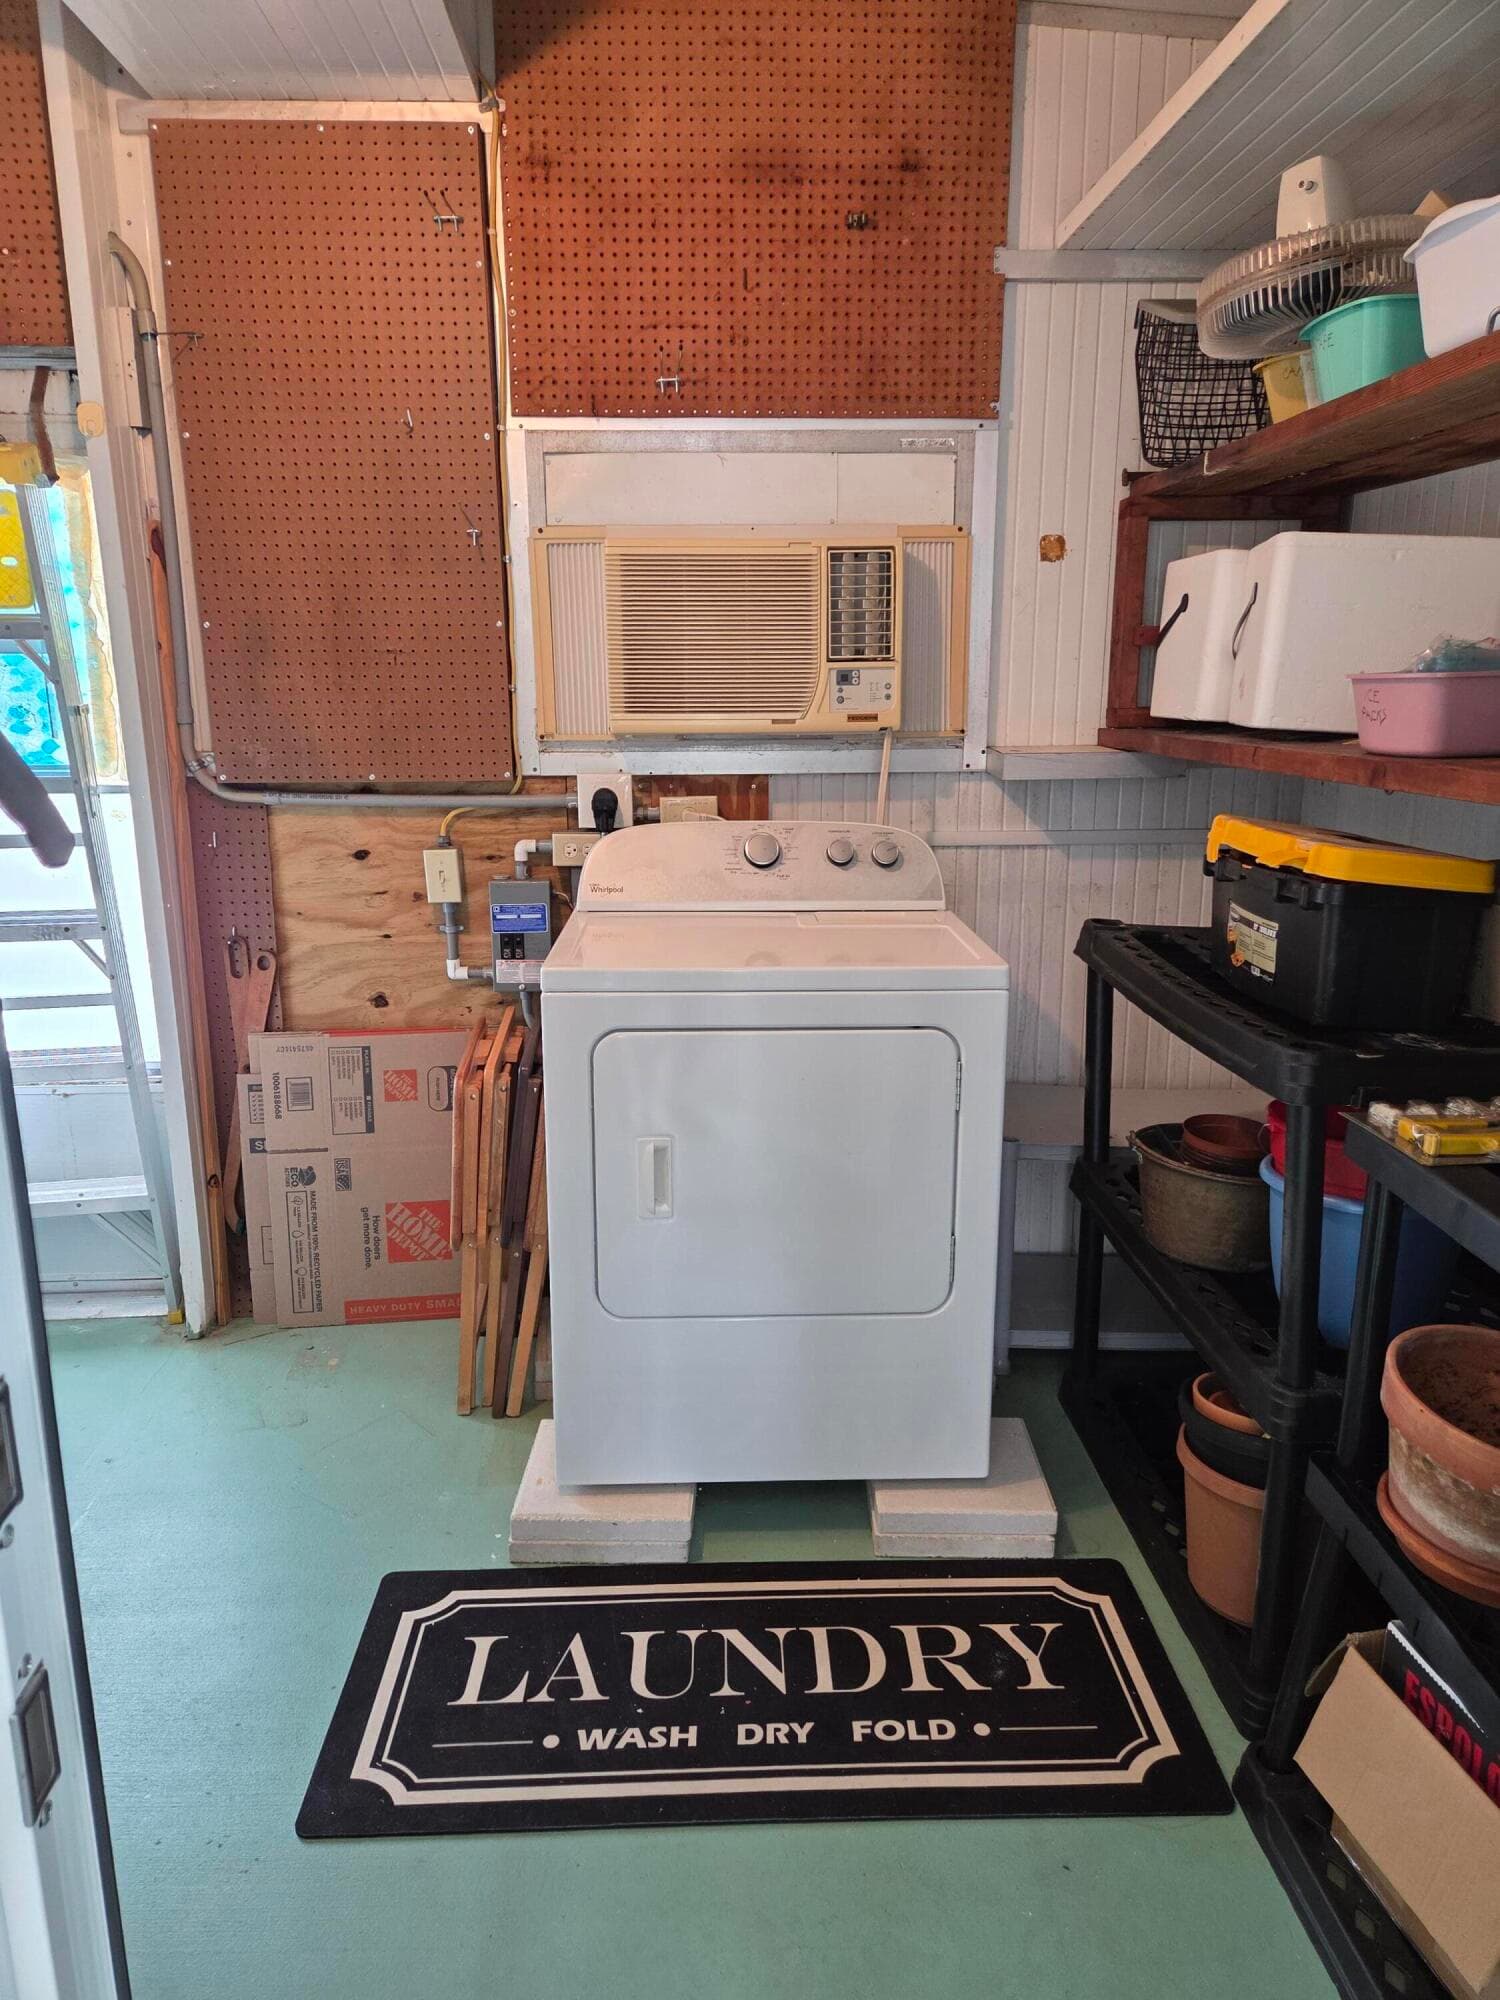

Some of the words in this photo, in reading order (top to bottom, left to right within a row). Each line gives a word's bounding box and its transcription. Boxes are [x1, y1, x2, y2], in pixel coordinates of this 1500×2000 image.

[591, 886, 624, 894] Whirlpool
[273, 1071, 283, 1120] 1006188668
[290, 1167, 299, 1187] ECO
[309, 1190, 317, 1211] MADE
[311, 1212, 319, 1232] FROM
[360, 1207, 370, 1222] get
[372, 1215, 381, 1234] How
[418, 1208, 444, 1231] THE
[312, 1234, 320, 1251] 100%
[386, 1202, 452, 1261] HOME
[373, 1236, 382, 1260] doers
[387, 1226, 430, 1261] DEPOT
[364, 1247, 373, 1270] done.
[312, 1253, 321, 1289] RECYCLED
[314, 1290, 323, 1313] PAPER
[350, 1304, 387, 1315] HEAVY
[391, 1302, 421, 1311] DUTY
[446, 1622, 1066, 1707] LAUNDRY
[576, 1725, 699, 1752] WASH
[737, 1721, 817, 1747] DRY
[851, 1718, 957, 1744] FOLD
